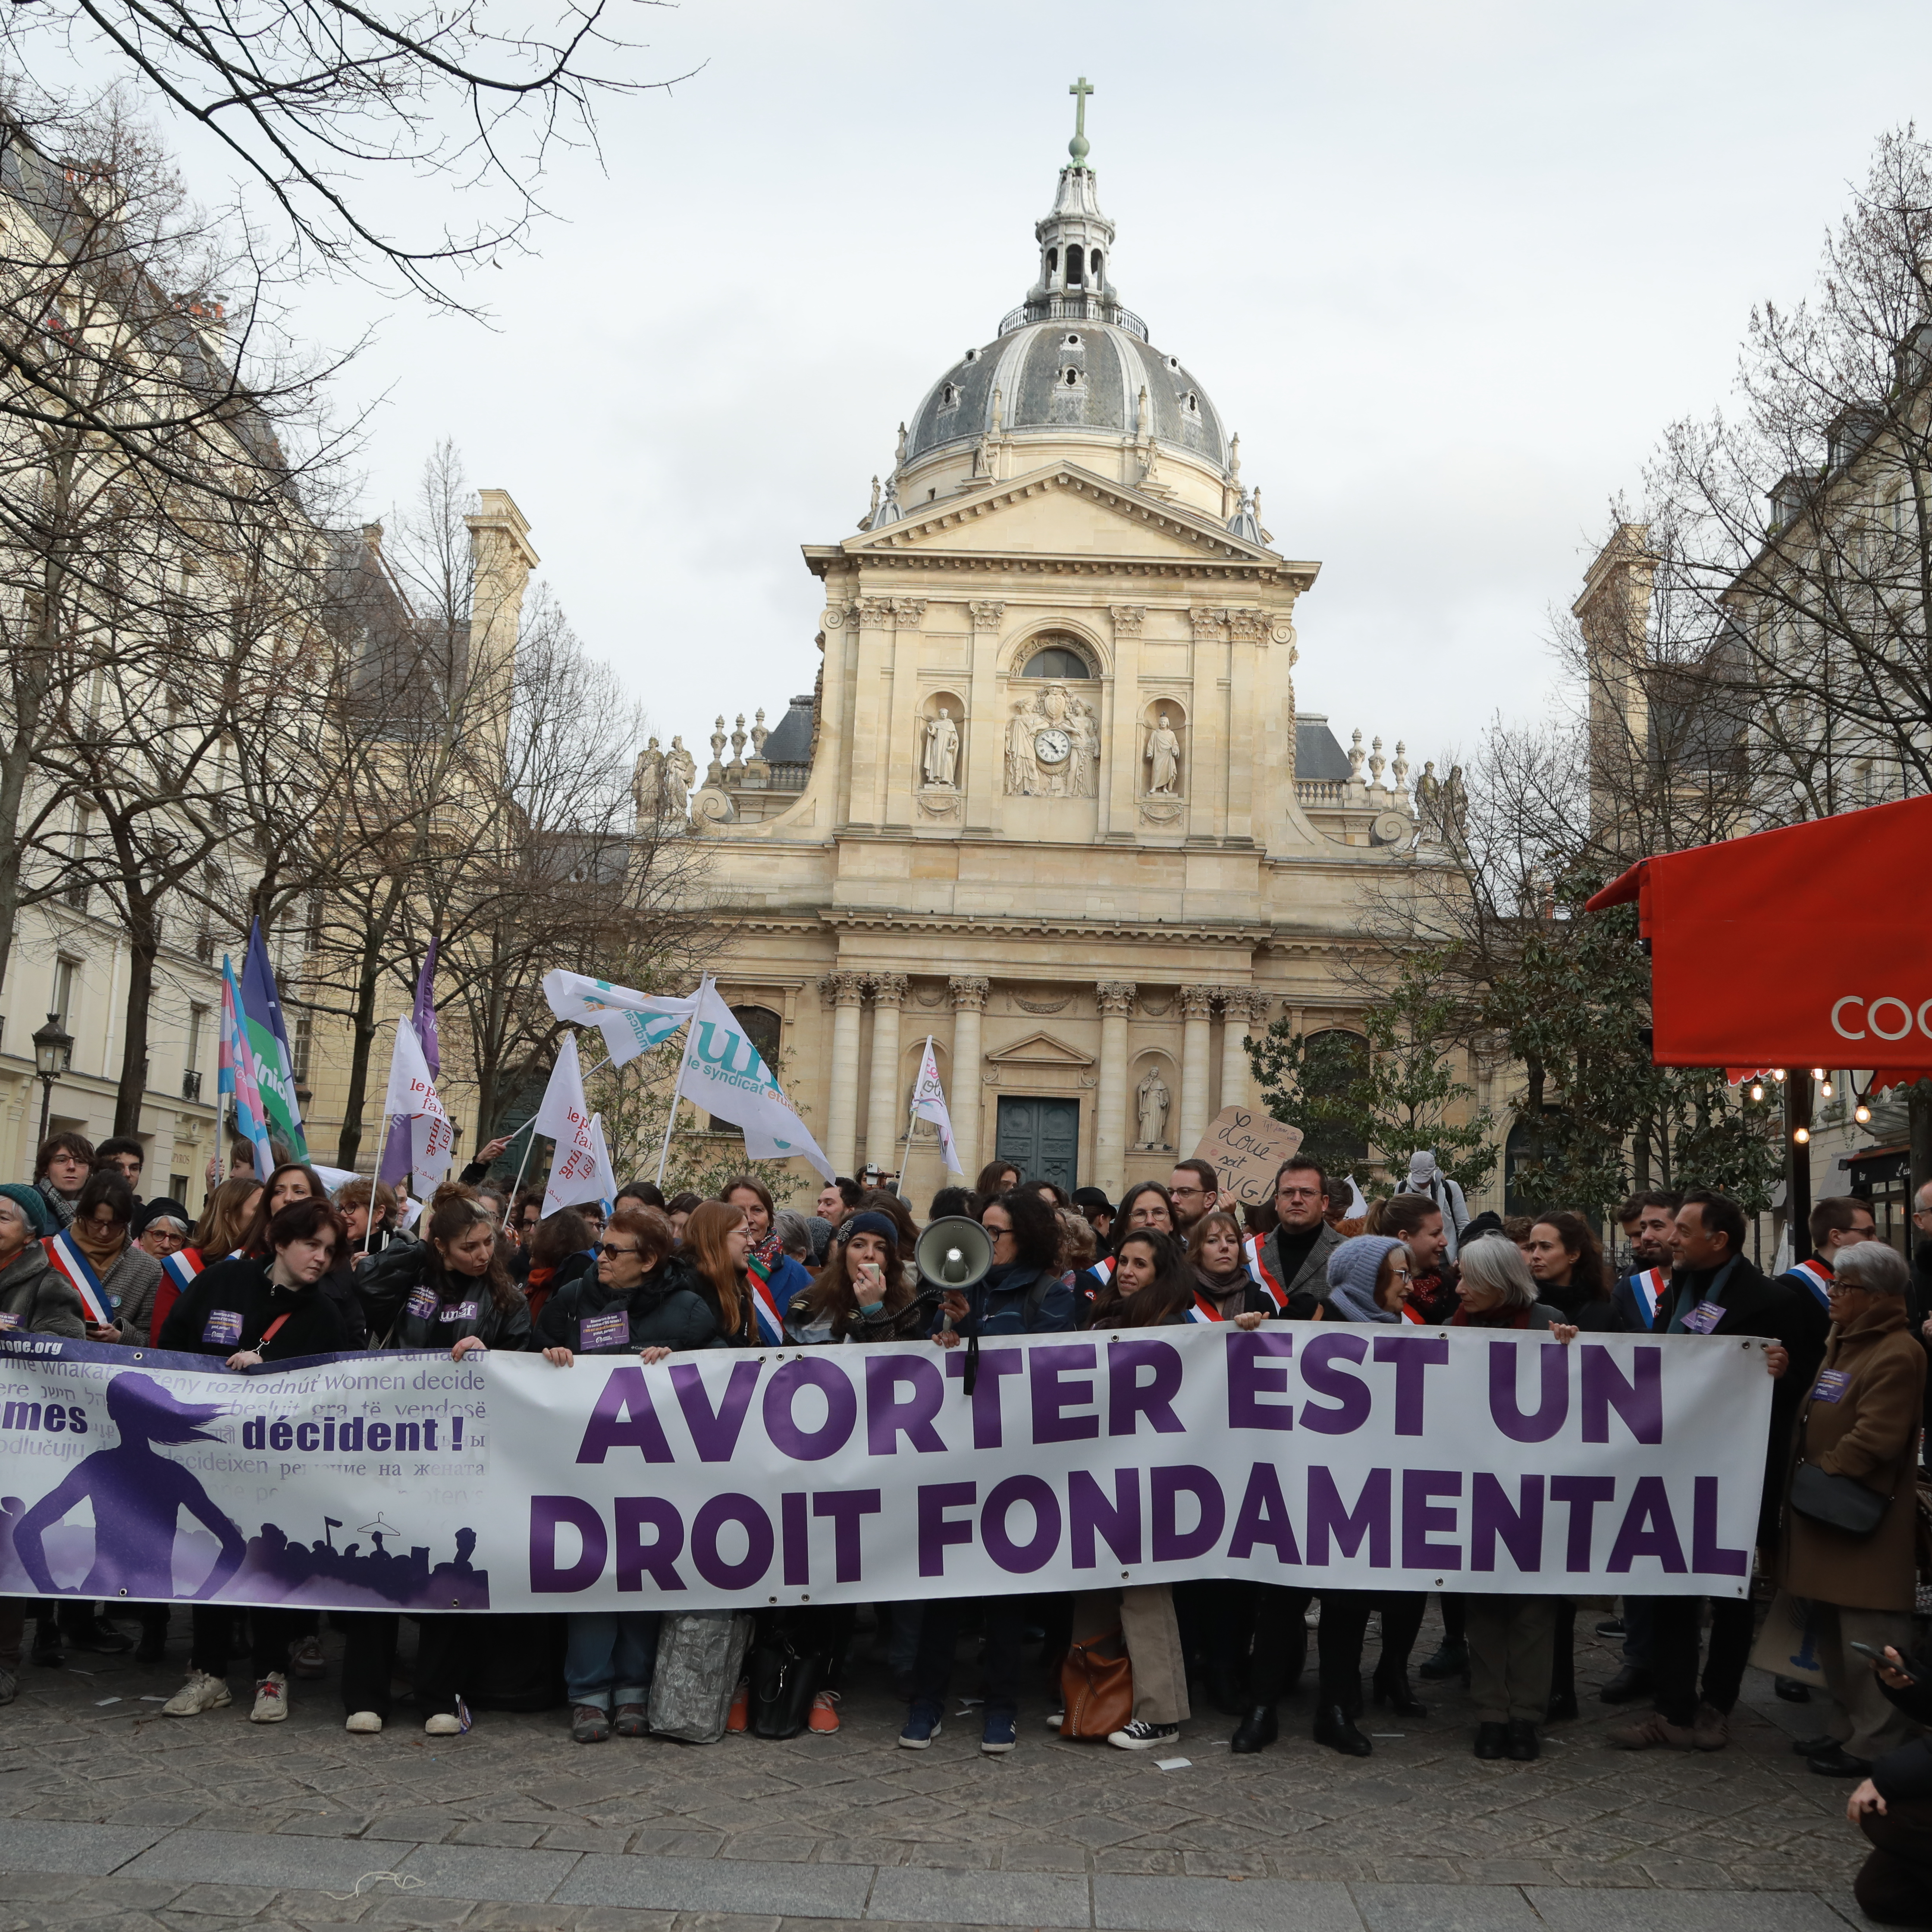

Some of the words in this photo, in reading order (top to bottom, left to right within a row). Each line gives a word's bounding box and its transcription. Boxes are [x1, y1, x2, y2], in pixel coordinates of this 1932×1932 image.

[253, 1052, 288, 1106] nio
[410, 1078, 425, 1092] le
[687, 1055, 700, 1070] le
[703, 1064, 765, 1095] syndicat
[567, 1106, 580, 1123] le
[577, 1116, 591, 1131] p
[1218, 1112, 1280, 1160] Loué
[1218, 1156, 1248, 1169] soit
[412, 1369, 485, 1390] decide
[575, 1340, 1187, 1464] AVORTER
[1226, 1333, 1449, 1436] EST
[1490, 1341, 1662, 1445] UN
[242, 1415, 439, 1452] décident
[452, 1416, 464, 1451] !
[378, 1463, 402, 1476] на
[529, 1489, 881, 1593] DROIT
[917, 1462, 1747, 1578] FONDAMENTAL
